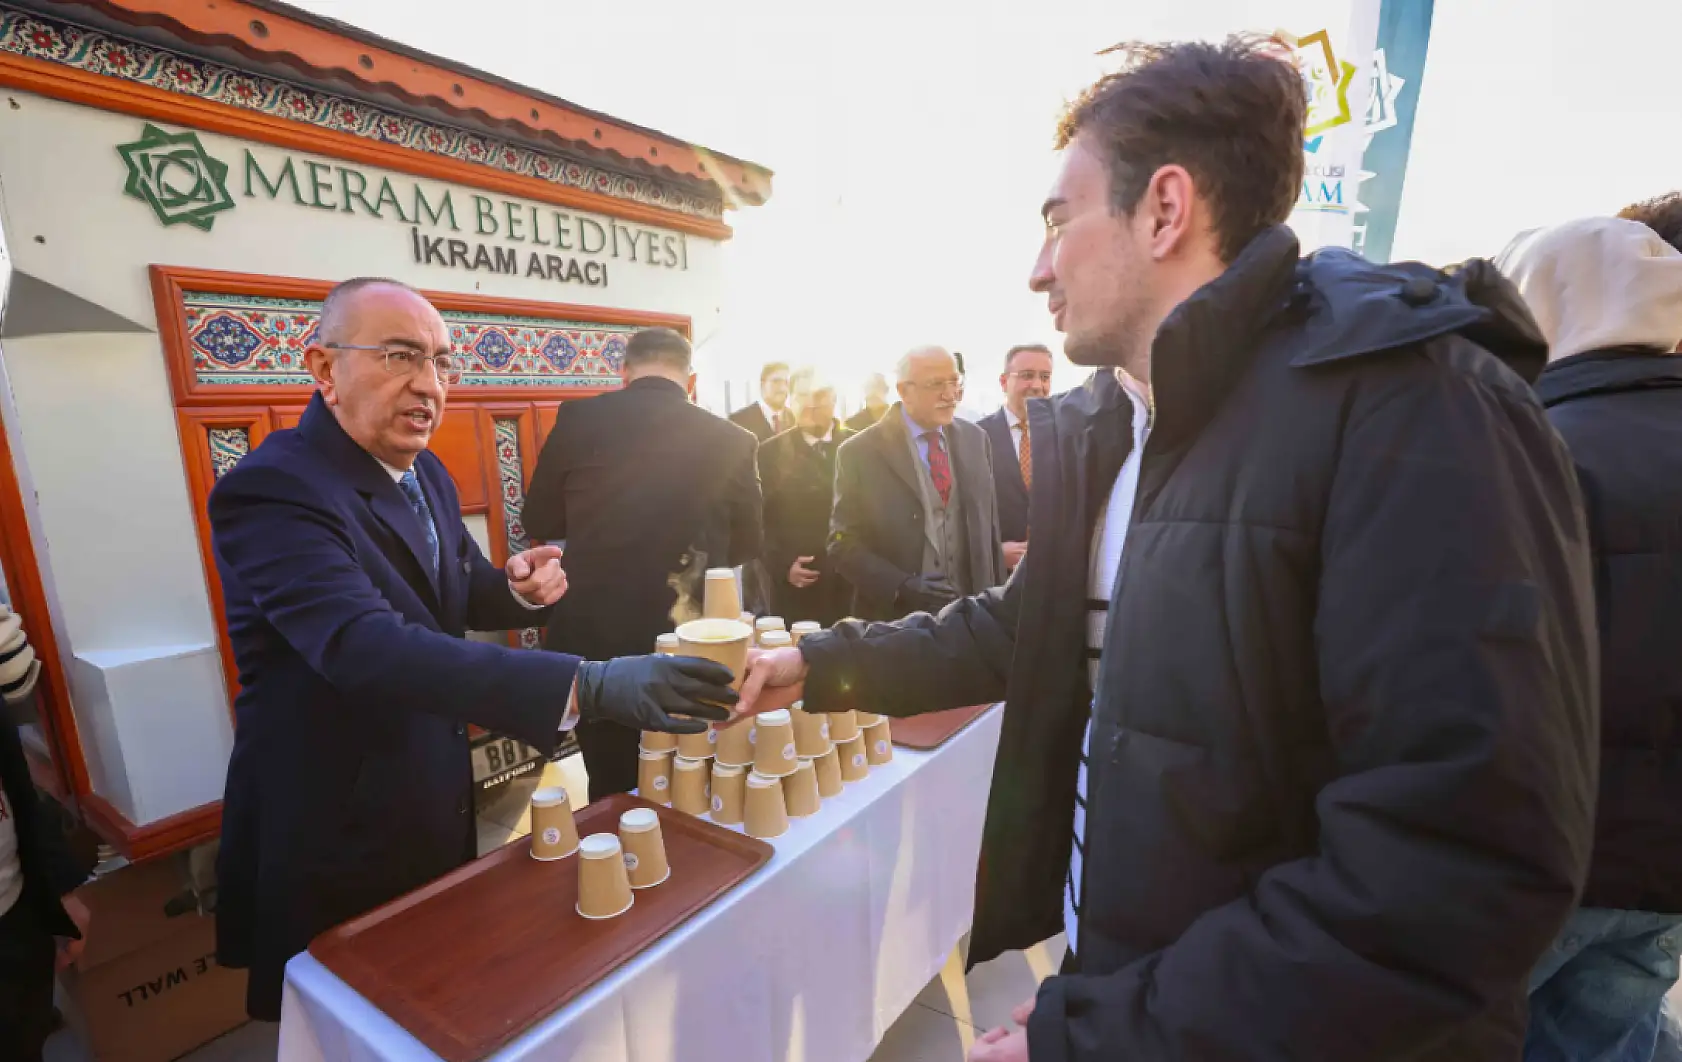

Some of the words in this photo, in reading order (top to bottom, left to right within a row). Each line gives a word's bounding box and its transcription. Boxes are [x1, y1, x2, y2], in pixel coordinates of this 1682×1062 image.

[244, 149, 460, 231] MERAM
[472, 194, 688, 270] BELEDİYESİ
[411, 226, 517, 275] İKRAM
[526, 251, 608, 287] ARACI
[117, 966, 188, 1007] WALL
